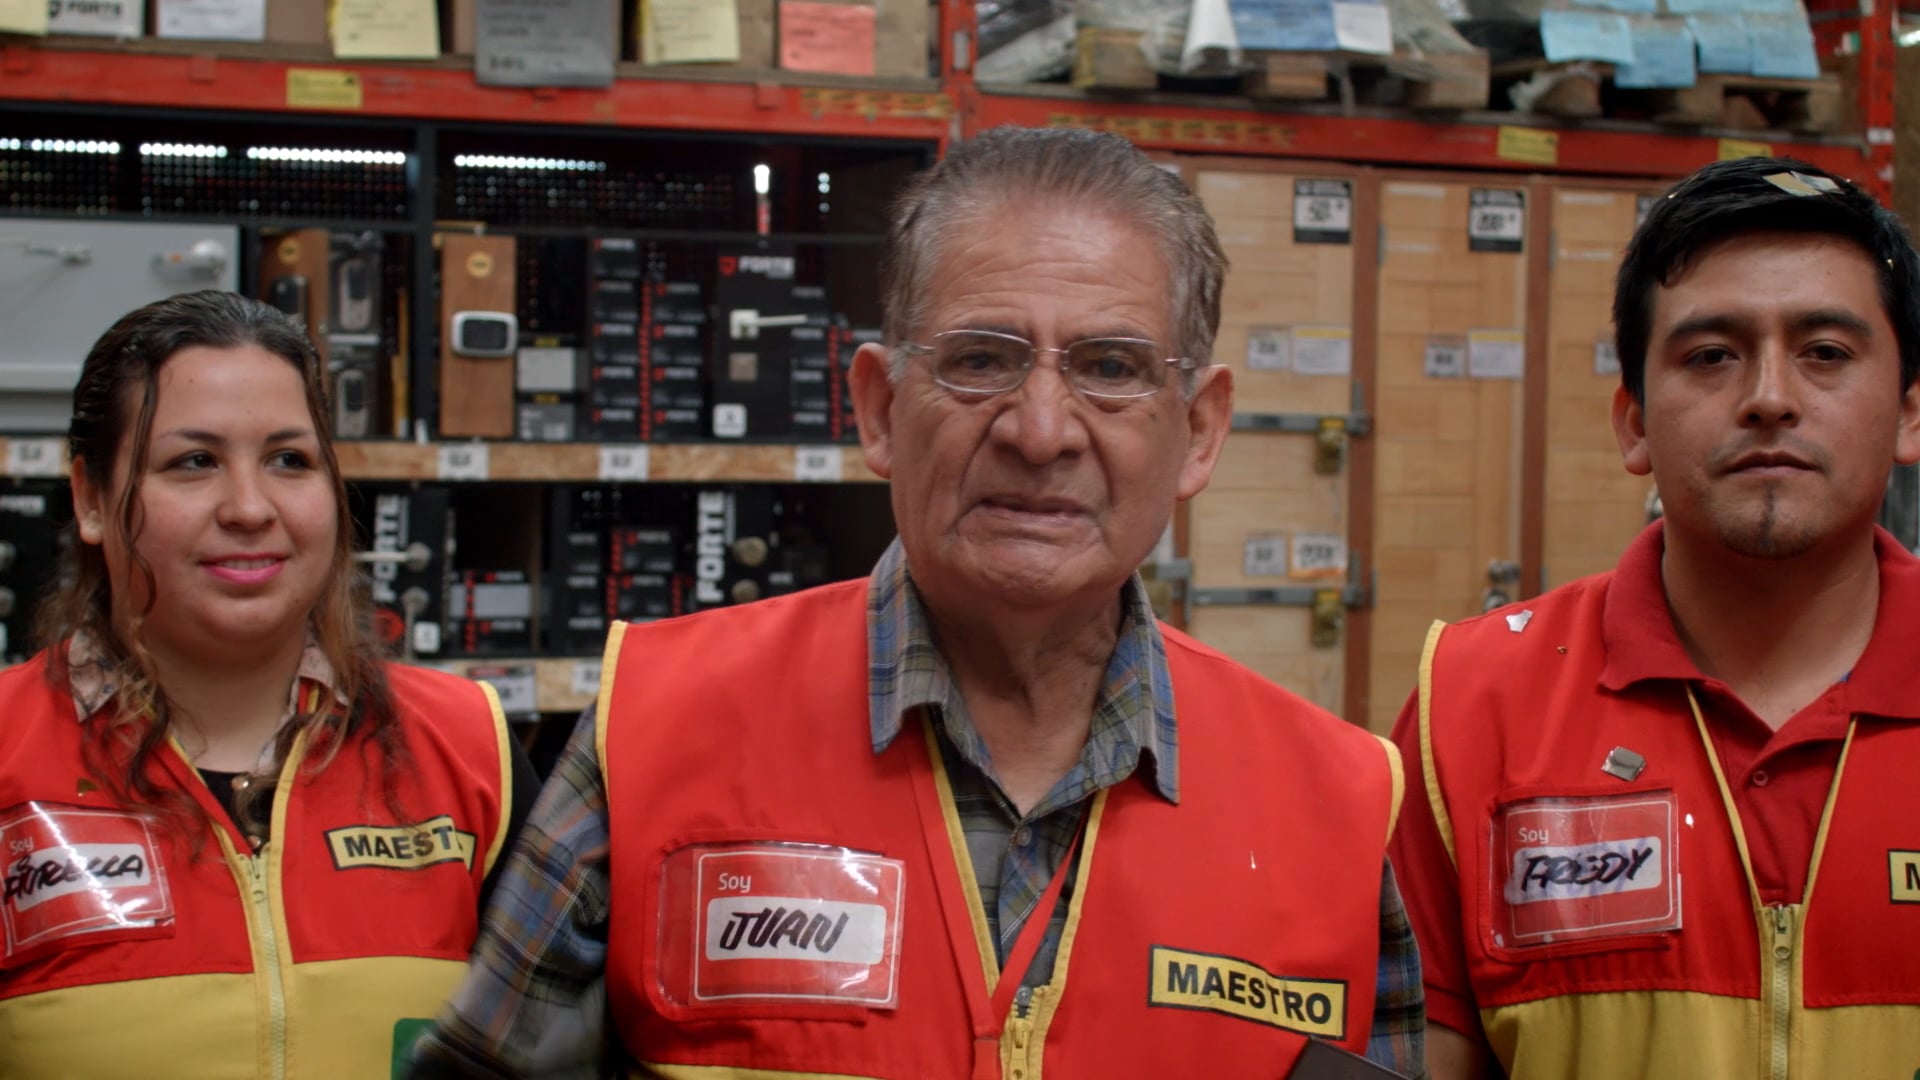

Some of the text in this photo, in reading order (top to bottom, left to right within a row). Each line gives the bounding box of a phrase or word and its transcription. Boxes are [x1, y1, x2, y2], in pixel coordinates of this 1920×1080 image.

[738, 256, 795, 273] FORTE
[373, 495, 399, 602] FORTE
[697, 492, 725, 602] FORTE
[9, 837, 34, 856] Soy
[343, 826, 463, 859] MAEST
[1518, 827, 1550, 844] Soy
[718, 873, 751, 893] Soy
[719, 906, 850, 953] JUAN
[1167, 960, 1333, 1024] MAESTRO
